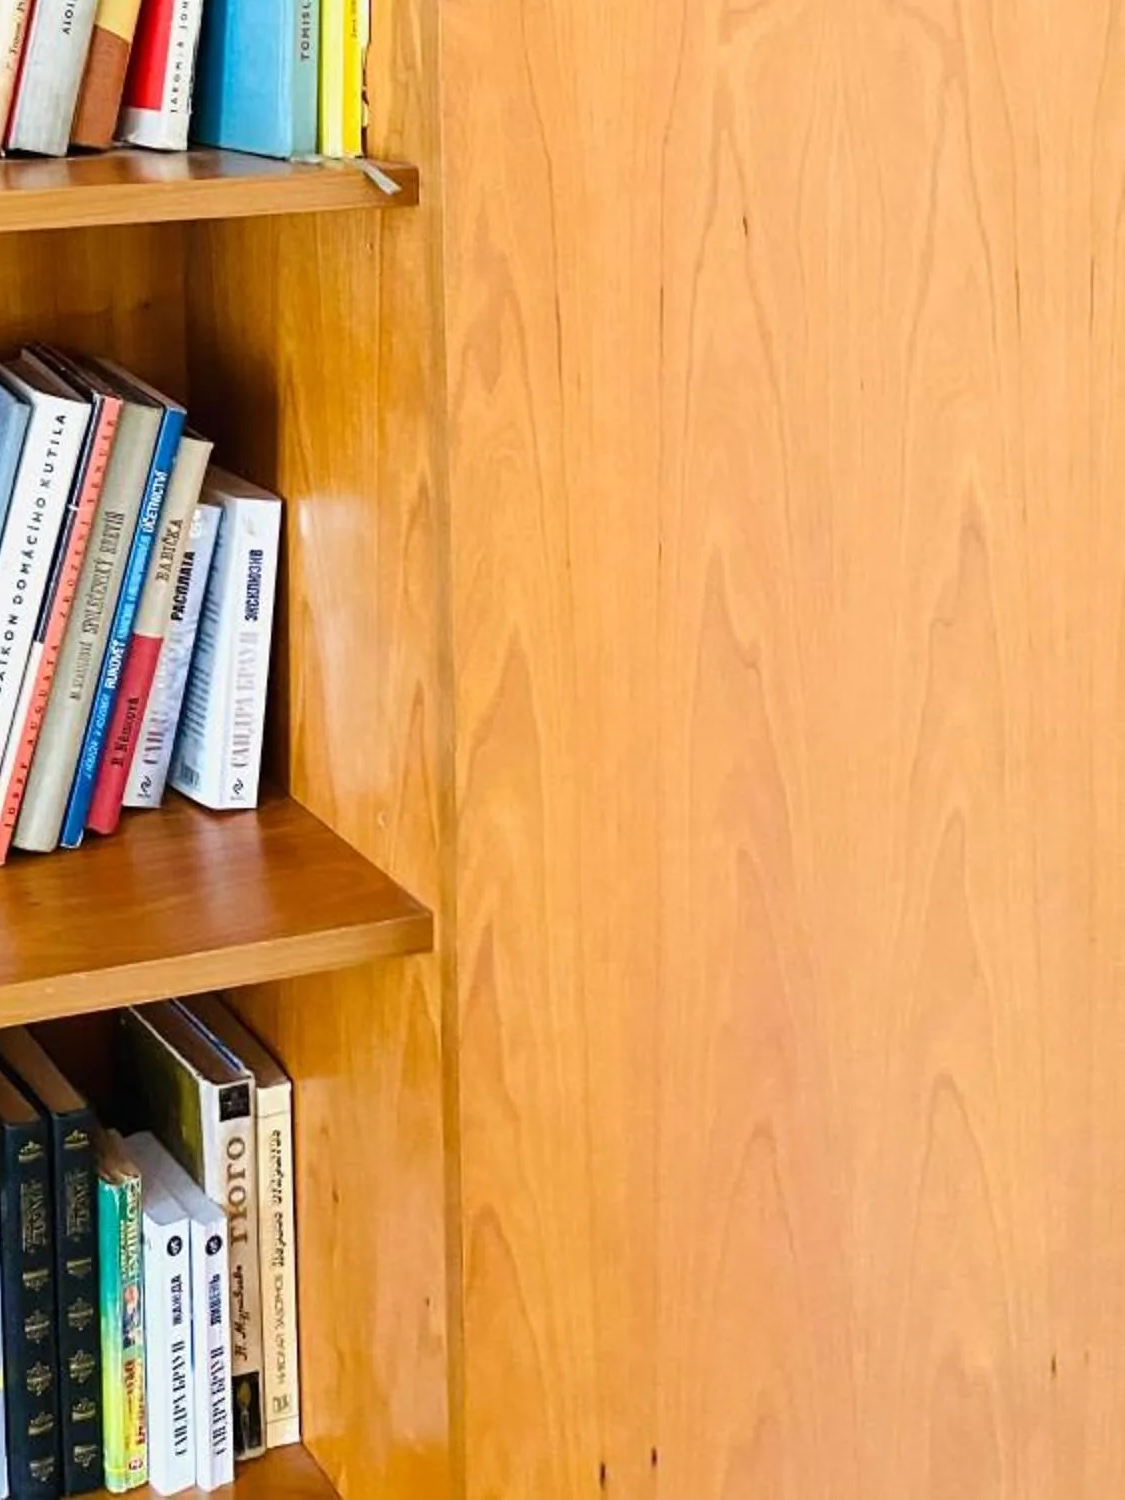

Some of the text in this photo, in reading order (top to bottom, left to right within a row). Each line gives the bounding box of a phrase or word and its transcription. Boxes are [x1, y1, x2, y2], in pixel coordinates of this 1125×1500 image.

[11, 494, 47, 606] DOMÁCÍHO
[41, 411, 66, 490] KUTILA
[152, 514, 183, 583] BABIČKA
[167, 548, 198, 622] РАСПЛАТА
[226, 694, 257, 769] САНДРА
[224, 1136, 249, 1246] ГЮГО
